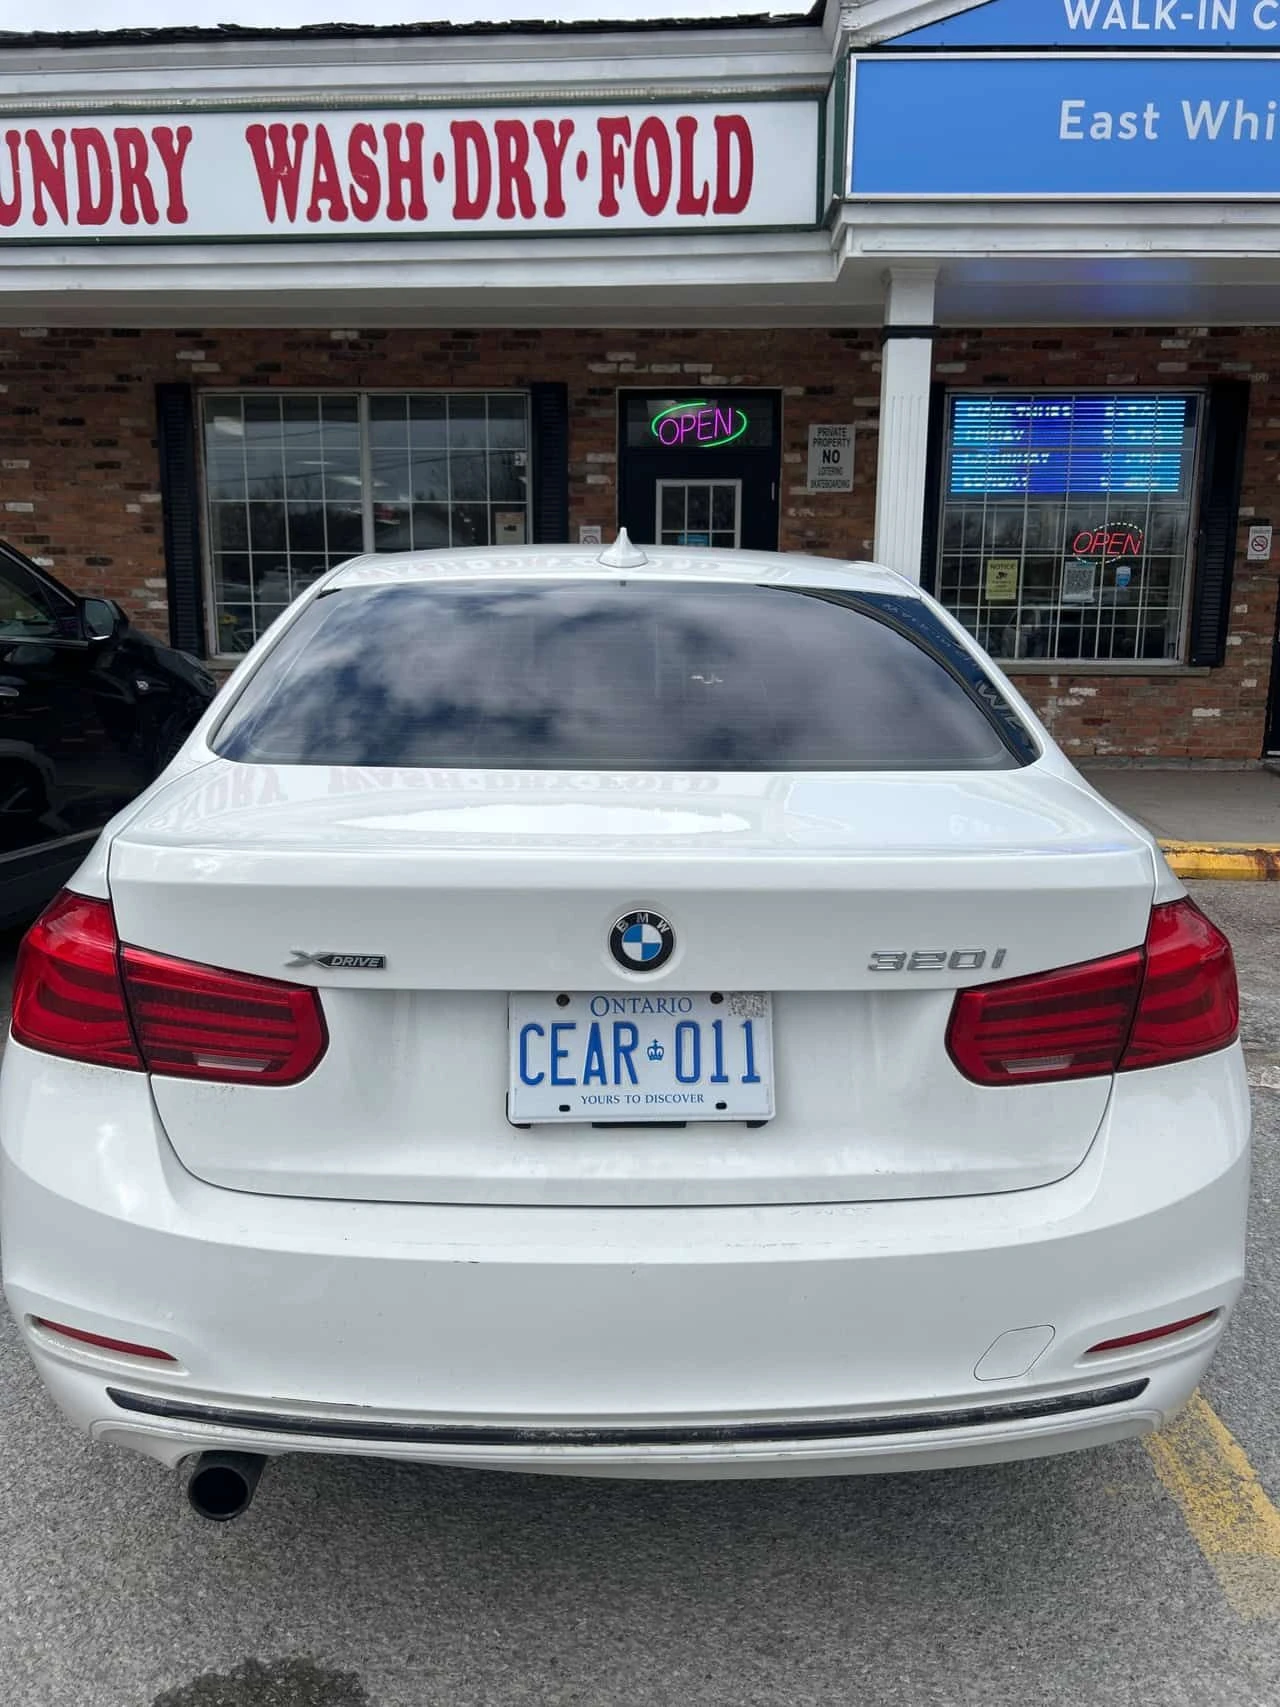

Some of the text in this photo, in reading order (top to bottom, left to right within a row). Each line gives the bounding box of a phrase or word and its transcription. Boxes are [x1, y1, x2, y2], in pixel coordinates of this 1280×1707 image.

[1063, 0, 1238, 30] WALK-IN
[1059, 99, 1160, 140] East
[658, 407, 732, 445] OPEN
[817, 427, 848, 437] PRIVATE
[813, 438, 850, 448] PROPERTY
[822, 449, 841, 464] NO
[1072, 530, 1143, 556] OPEN
[616, 912, 670, 933] BMW
[519, 1019, 761, 1086] CEAR 011
[581, 1093, 704, 1105] YOURS TO DISCOVER
